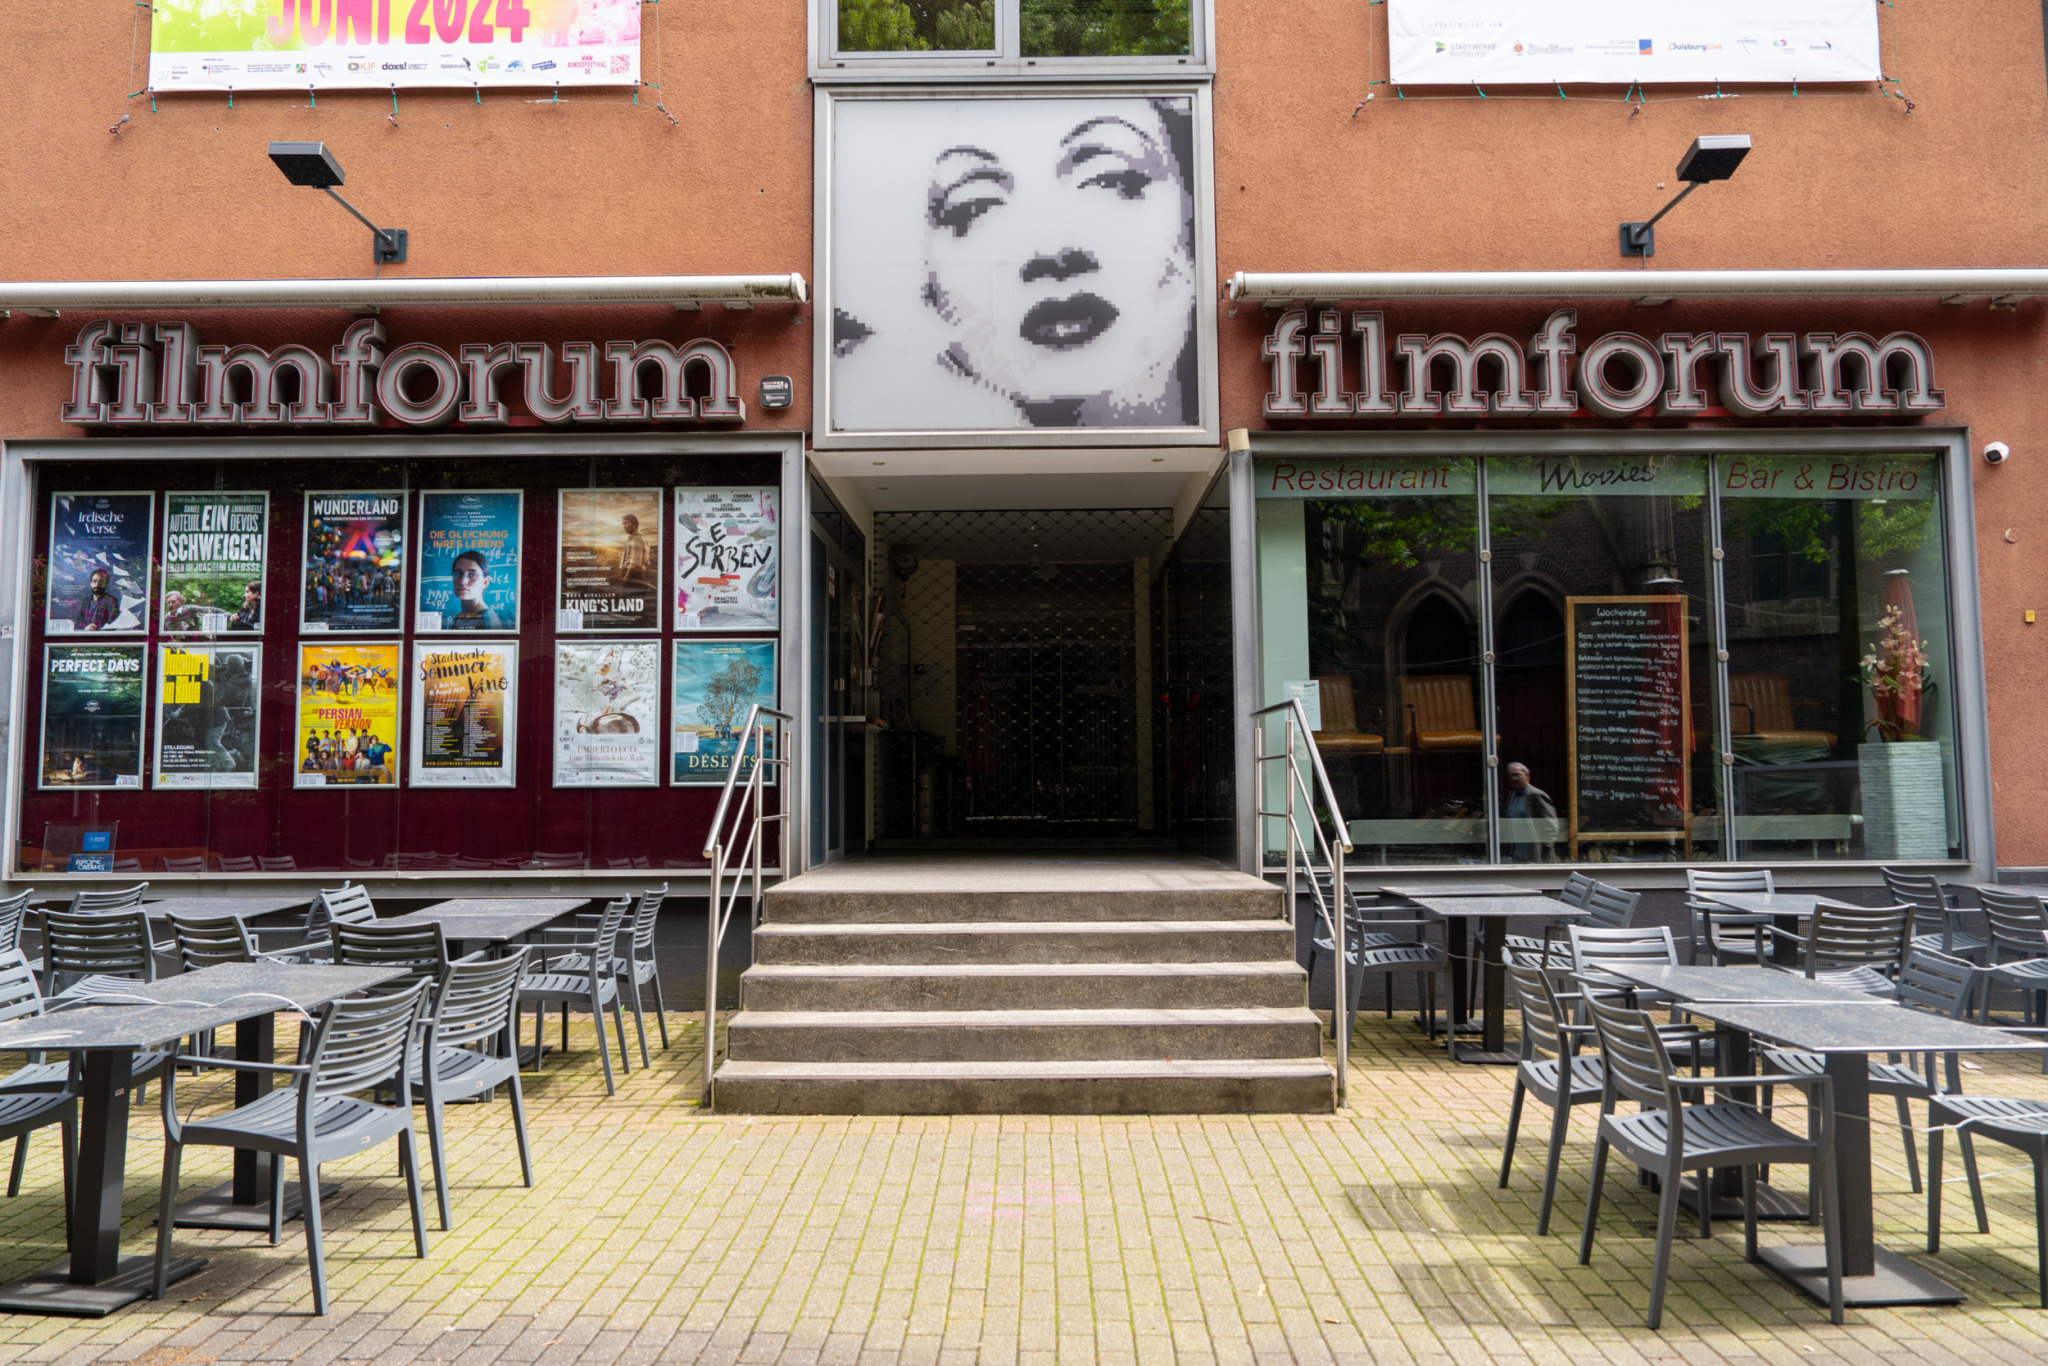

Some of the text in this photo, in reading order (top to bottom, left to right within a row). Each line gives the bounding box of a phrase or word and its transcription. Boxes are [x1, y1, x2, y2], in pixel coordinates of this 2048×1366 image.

[1450, 43, 1497, 51] STADTWERKE
[360, 62, 376, 70] KJF
[381, 62, 407, 71] doxs!
[1262, 308, 1946, 418] filmforum
[61, 319, 746, 427] filmforum
[1271, 462, 1450, 493] Restaurant
[1535, 458, 1657, 495] Movies
[1726, 462, 1918, 492] Bar & Bistro
[313, 499, 399, 516] WUNDERLAND
[78, 510, 125, 523] Irdische
[169, 513, 200, 532] AUTEUIL
[201, 504, 230, 532] EIN
[230, 513, 259, 532] DEVOS
[85, 523, 117, 534] Verse
[430, 530, 508, 539] DIE GLEICHUNG
[167, 533, 263, 562] SCHWEIGEN
[433, 540, 505, 549] IHRES LEBENS
[193, 563, 227, 572] JOACHIM
[227, 562, 261, 572] LAFOSSE
[566, 598, 644, 613] KING'S LAND
[1597, 607, 1647, 617] Wochenkarte
[51, 659, 140, 672] PERFECT DAYS
[467, 676, 509, 697] kino
[318, 708, 362, 719] PERSIAN
[334, 718, 372, 730] VERSION
[688, 752, 757, 768] DÉSETS
